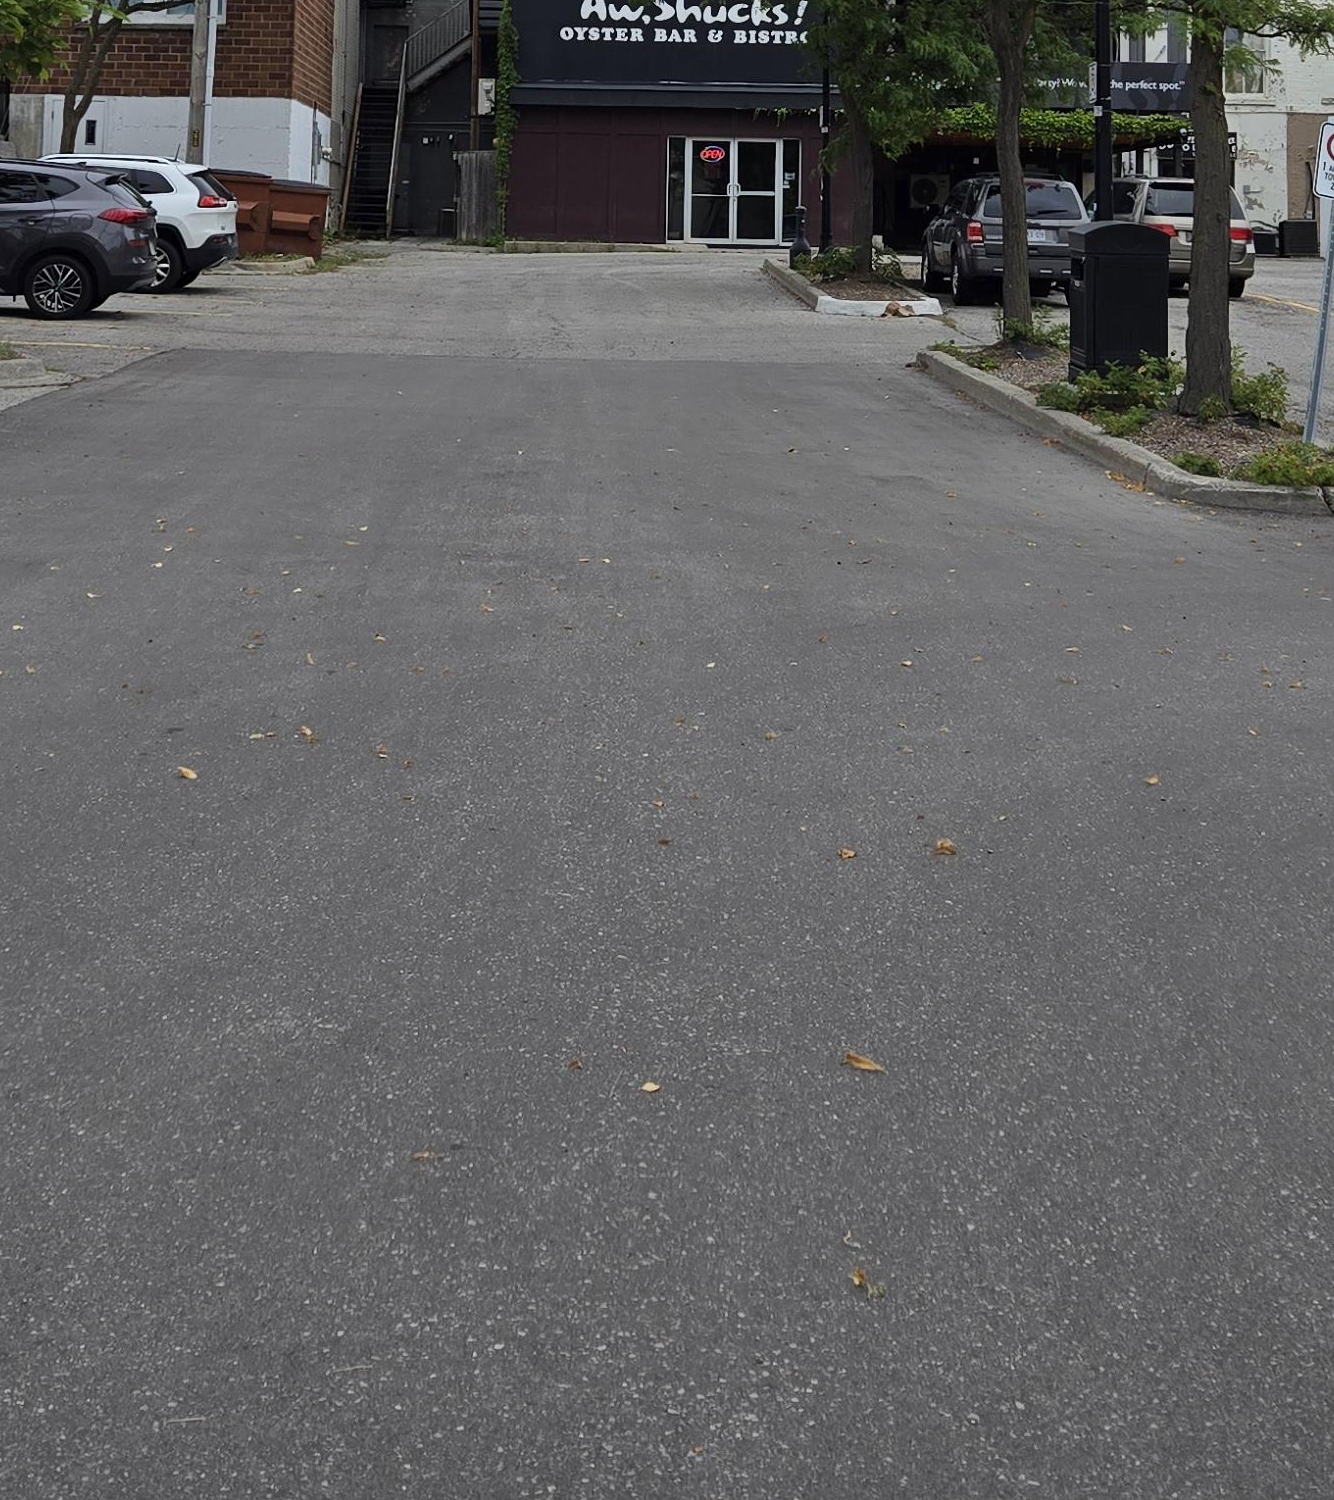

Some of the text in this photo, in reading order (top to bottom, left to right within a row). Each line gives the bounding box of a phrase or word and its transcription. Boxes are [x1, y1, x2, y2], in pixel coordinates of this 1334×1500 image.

[559, 26, 644, 42] OYSTER
[654, 28, 697, 43] BAR
[707, 29, 723, 43] &
[1125, 80, 1157, 91] perfect
[702, 149, 722, 159] OPEN
